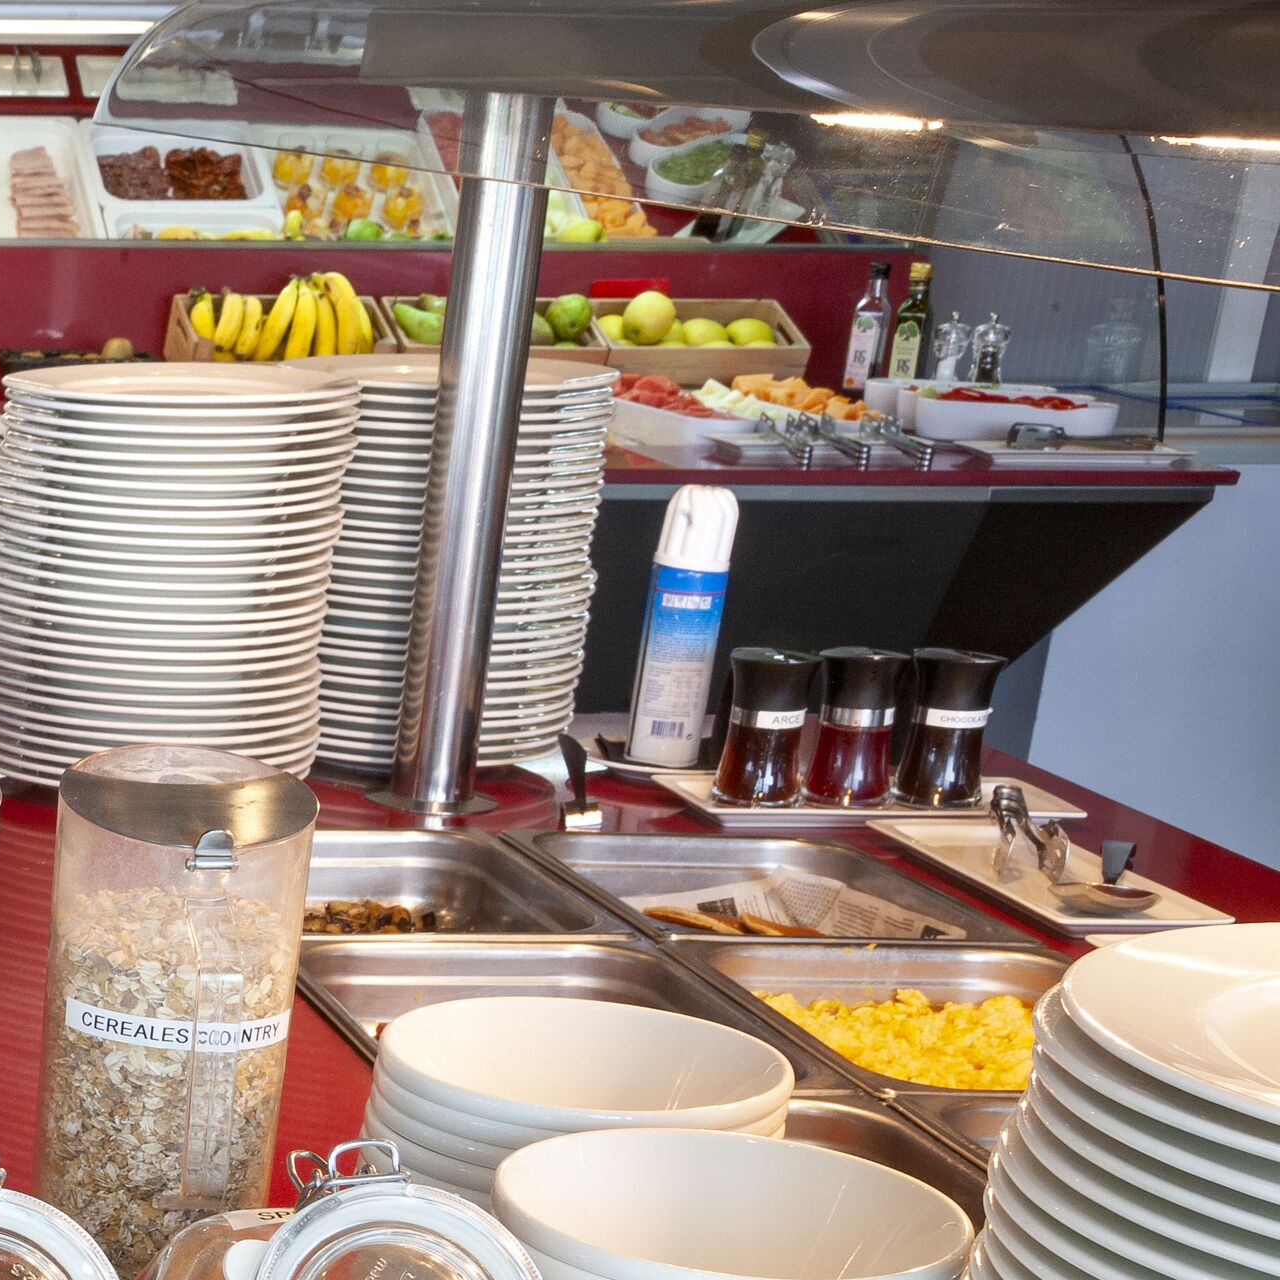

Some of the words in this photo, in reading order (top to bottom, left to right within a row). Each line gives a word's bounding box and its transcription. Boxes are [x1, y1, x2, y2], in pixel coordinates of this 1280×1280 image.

[772, 715, 801, 725] ARCE
[81, 1011, 189, 1044] CEREALES
[198, 1021, 281, 1046] CONTRY
[257, 1211, 295, 1221] SP
